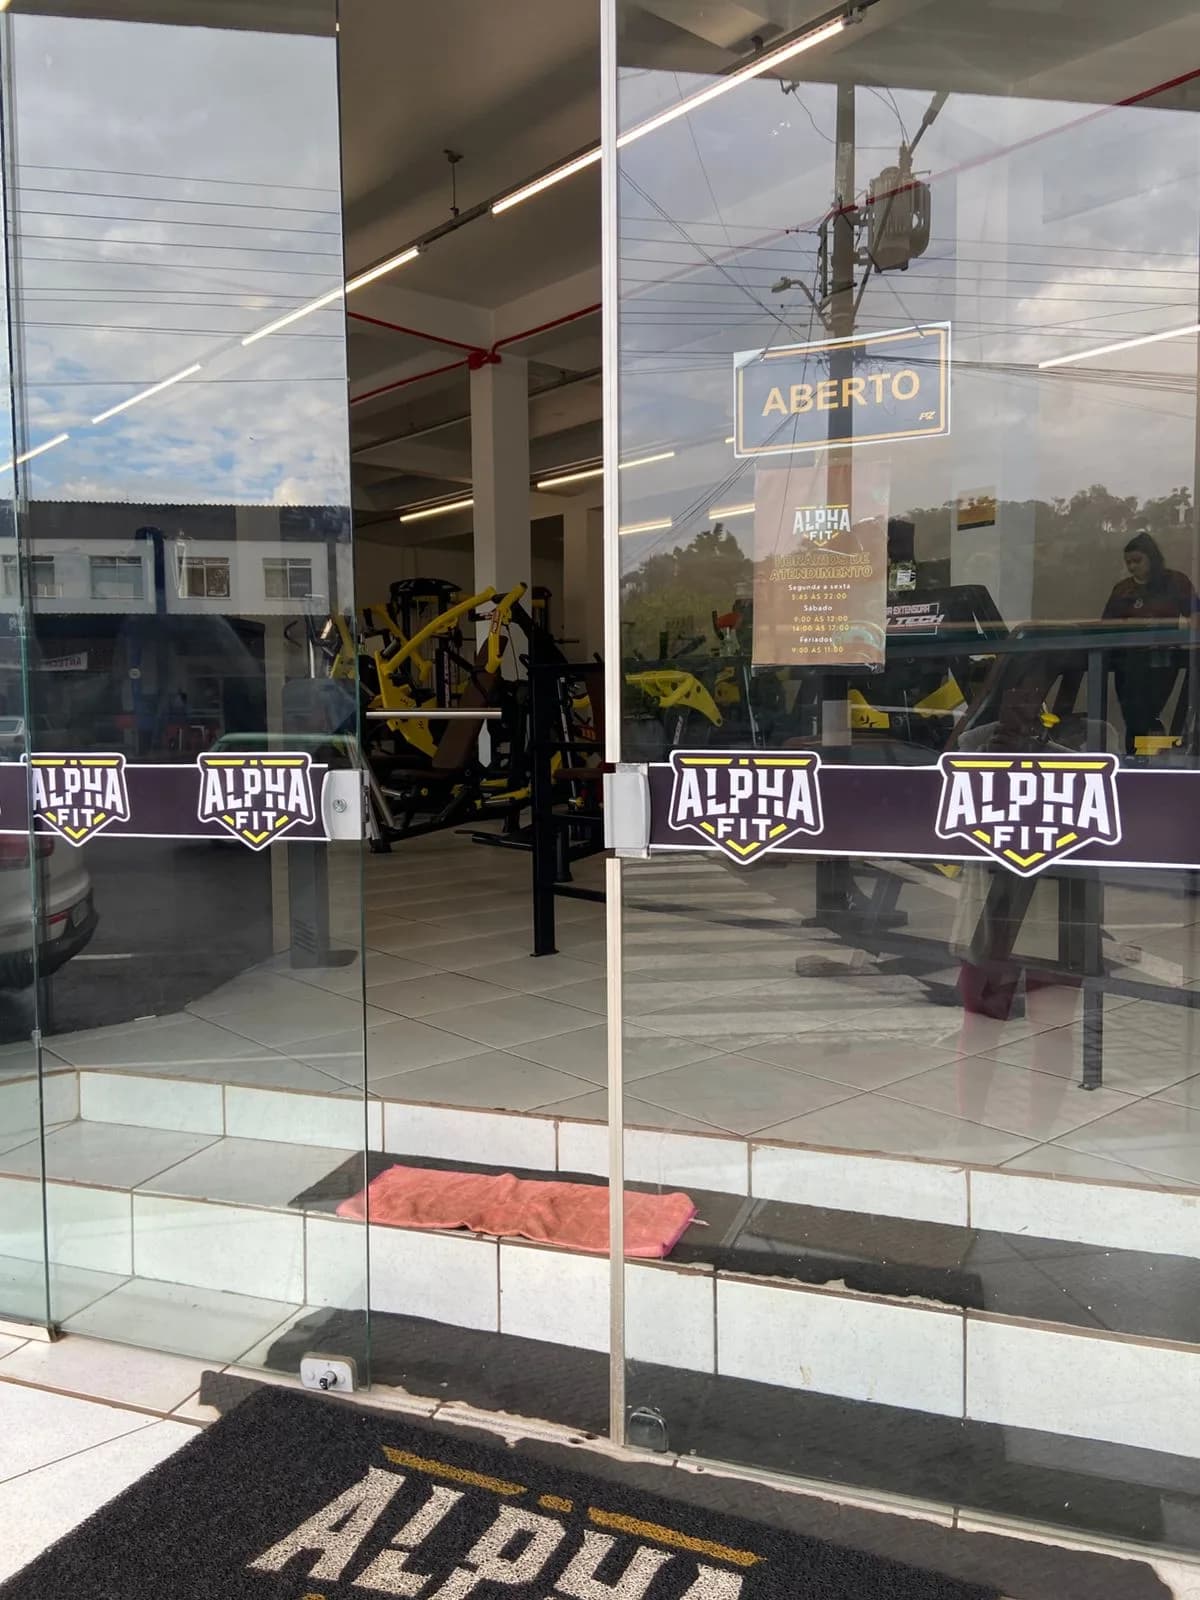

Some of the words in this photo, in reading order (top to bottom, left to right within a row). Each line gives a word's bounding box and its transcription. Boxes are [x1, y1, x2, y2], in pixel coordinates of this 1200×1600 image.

[762, 369, 920, 417] ABERTO
[792, 508, 851, 535] ALPHA
[809, 530, 833, 541] FIT
[769, 565, 873, 581] ATENDIMENTO
[896, 614, 945, 625] TECH
[204, 767, 310, 816] ALPHA
[676, 768, 815, 826] ALPHA
[945, 771, 1112, 836] ALPHA
[57, 808, 95, 827] FIT
[235, 811, 277, 831] FIT
[717, 817, 773, 841] FIT
[993, 825, 1059, 851] FIT
